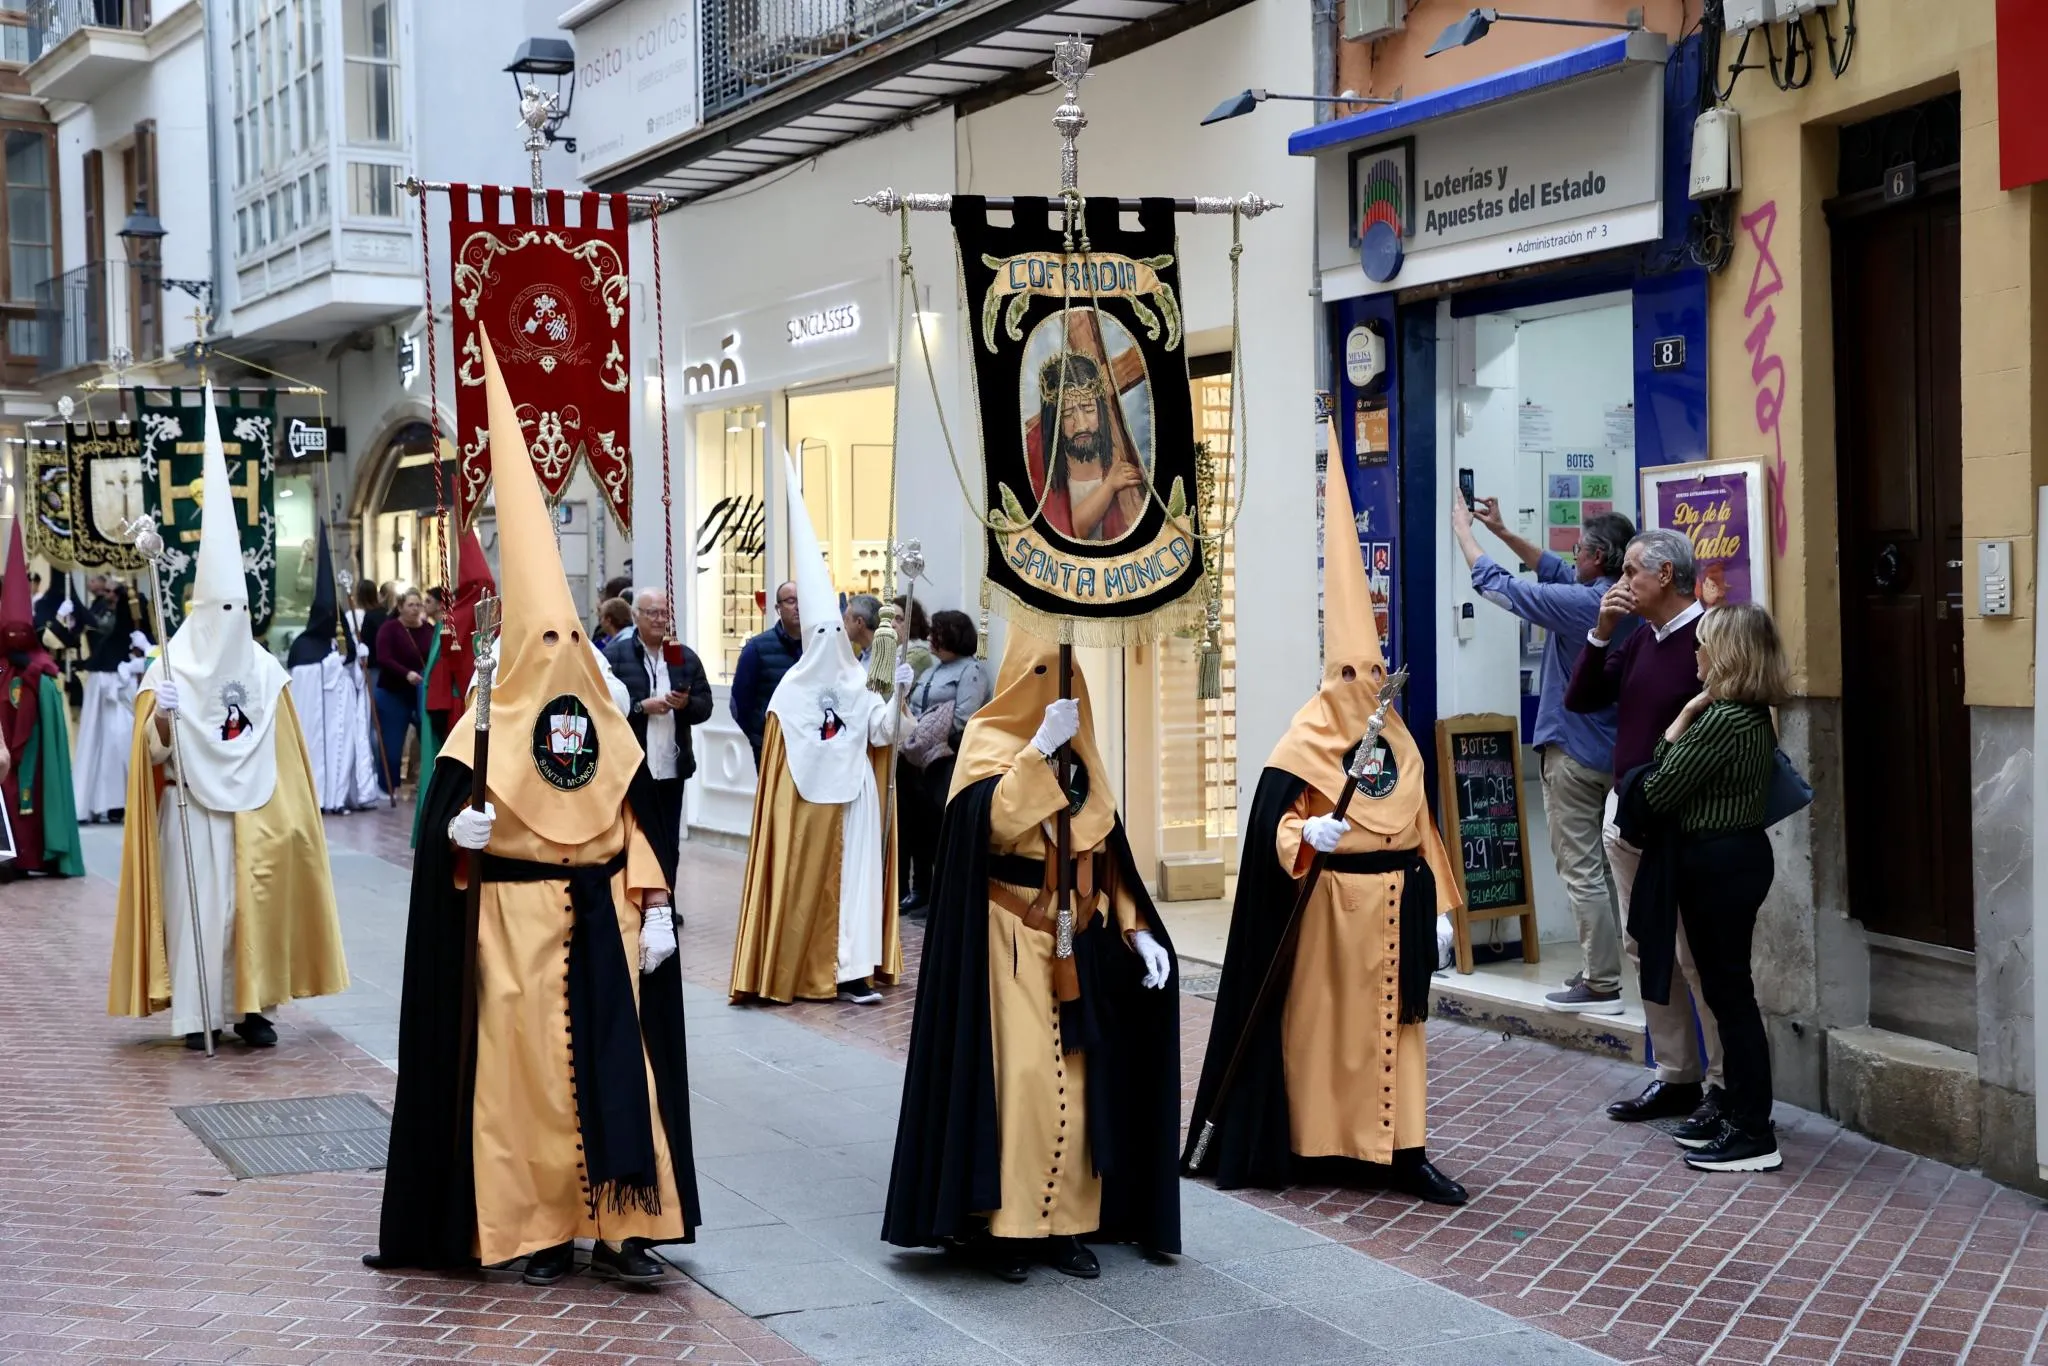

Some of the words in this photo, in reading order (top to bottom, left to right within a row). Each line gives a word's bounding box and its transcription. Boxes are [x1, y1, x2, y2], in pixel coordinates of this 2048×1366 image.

[579, 48, 622, 90] rosita
[636, 12, 688, 61] carlos
[1424, 166, 1493, 201] Loterías
[1497, 165, 1508, 191] y
[1893, 172, 1904, 195] 6
[1425, 198, 1504, 236] Apuestas
[1508, 184, 1535, 214] del
[1541, 170, 1606, 207] Estado
[1516, 230, 1582, 254] Administración
[1586, 226, 1597, 241] nº
[1601, 224, 1607, 237] 3
[1009, 258, 1137, 292] COFRADIA
[1661, 343, 1673, 363] 8
[1566, 453, 1594, 469] BOTES
[1701, 501, 1716, 524] de
[1717, 500, 1732, 521] la
[1011, 537, 1095, 597] SANTA
[1103, 536, 1193, 598] MONICA
[1460, 736, 1498, 755] BOTES
[539, 758, 563, 786] SANTA
[567, 761, 595, 787] MONICA
[1463, 779, 1479, 820] 1
[1464, 838, 1488, 869] 29
[1497, 840, 1518, 869] 17
